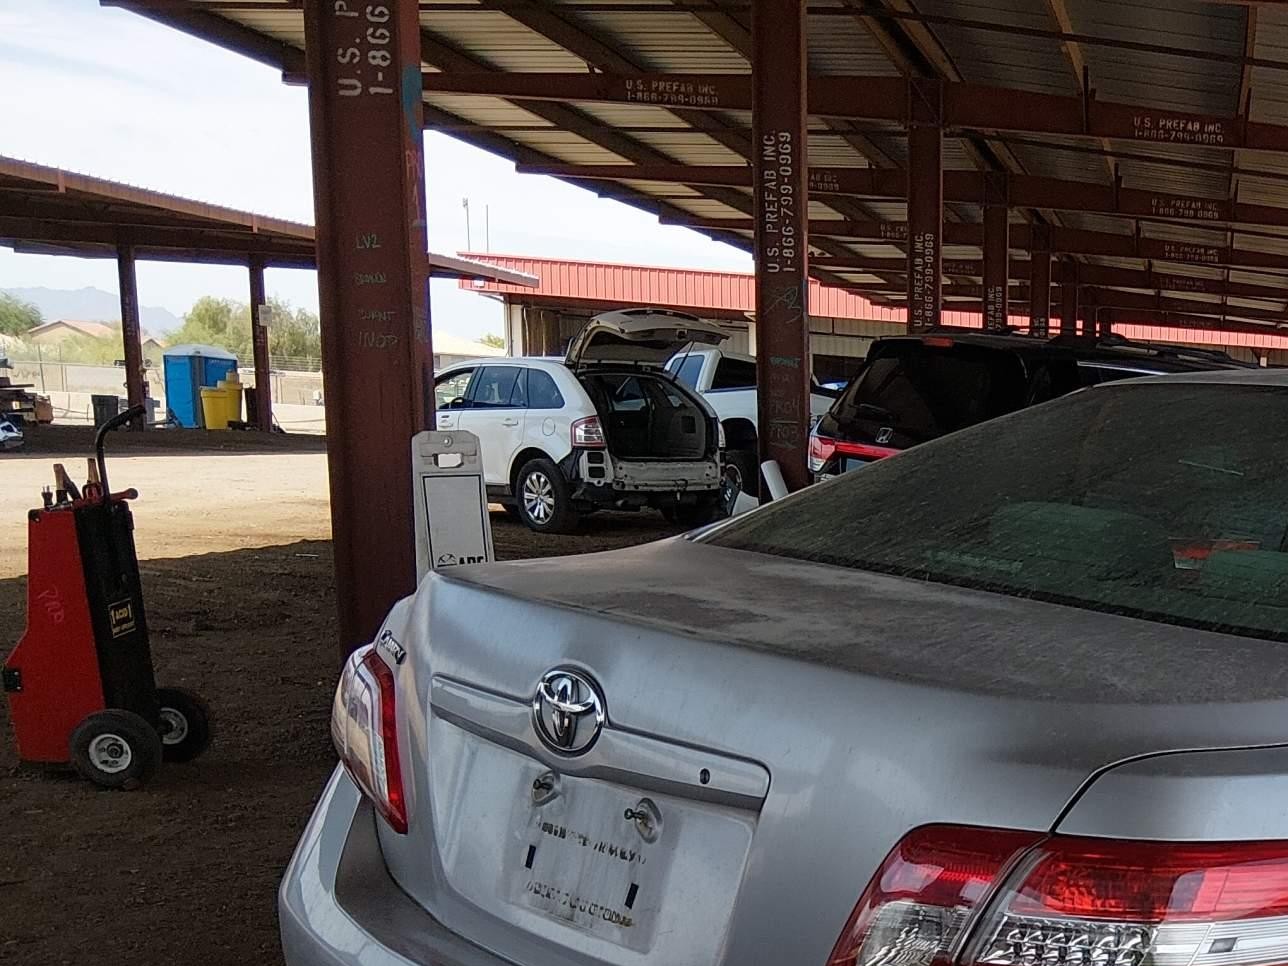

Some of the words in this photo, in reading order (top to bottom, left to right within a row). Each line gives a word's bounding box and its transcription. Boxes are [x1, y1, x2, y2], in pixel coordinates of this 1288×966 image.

[337, 37, 362, 97] U.S.
[762, 129, 777, 161] INC.
[1159, 118, 1201, 132] PREFAB
[763, 169, 779, 233] PREFAB
[778, 131, 796, 272] 1-866-799-0969
[765, 241, 780, 273] U.S.
